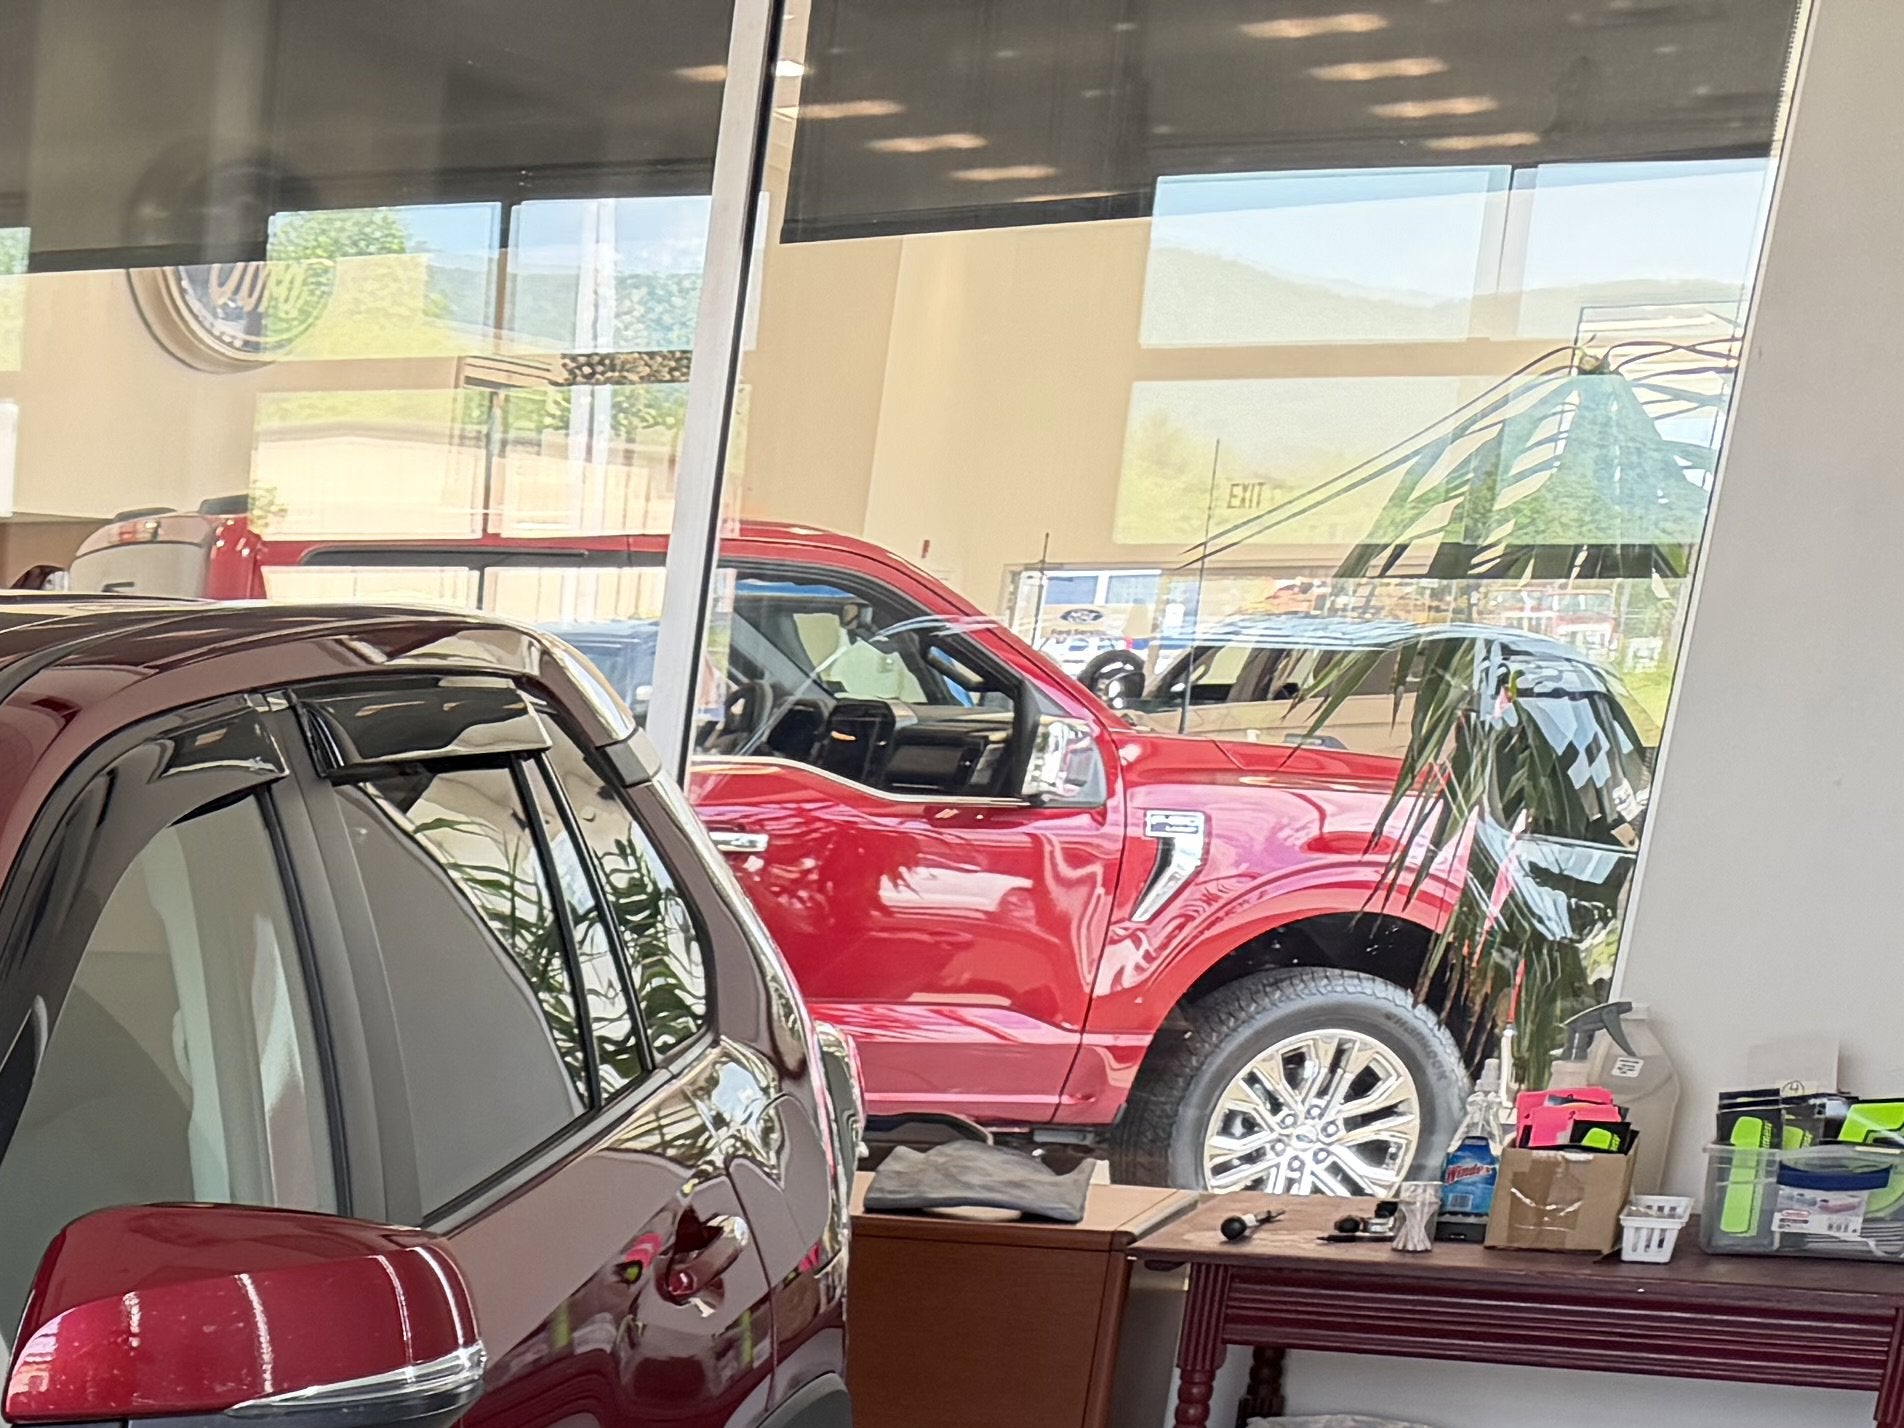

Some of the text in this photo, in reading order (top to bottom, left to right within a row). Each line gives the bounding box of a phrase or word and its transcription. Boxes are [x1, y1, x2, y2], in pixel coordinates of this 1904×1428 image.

[1227, 481, 1267, 509] EXIT
[1789, 1082, 1800, 1094] 4
[1446, 1163, 1492, 1185] Windex
